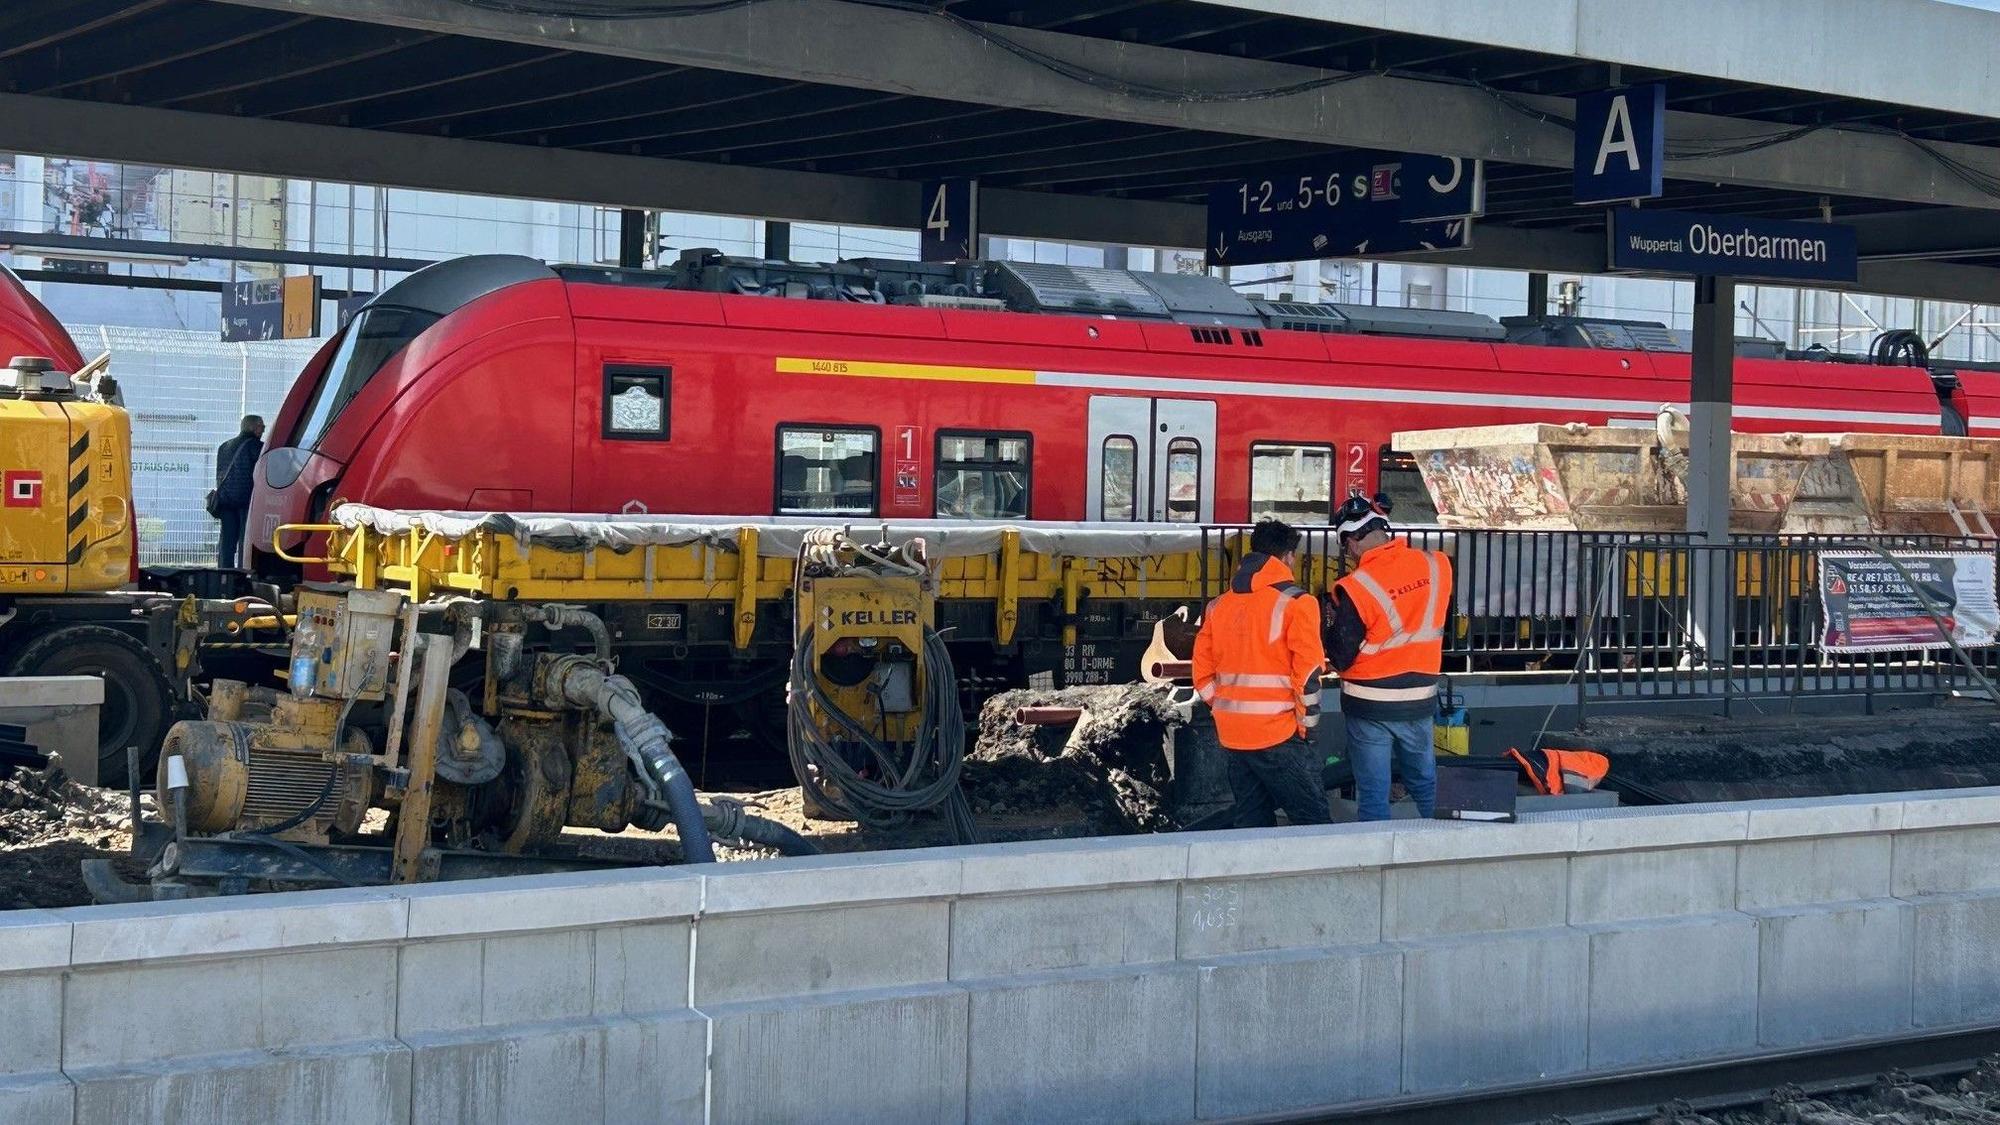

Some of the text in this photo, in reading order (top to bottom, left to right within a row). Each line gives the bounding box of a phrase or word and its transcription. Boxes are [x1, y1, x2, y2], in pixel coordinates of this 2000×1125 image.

[1593, 95, 1640, 176] A
[1239, 180, 1273, 214] 1-2
[1277, 199, 1293, 211] und
[1298, 173, 1341, 208] 5-6
[927, 184, 949, 241] 4
[1238, 229, 1273, 242] Ausgang
[1629, 223, 1827, 262] Wuppertal Oberbarmen
[235, 283, 249, 306] 1-4
[812, 361, 832, 373] 1440
[901, 428, 912, 459] 1
[131, 461, 190, 473] OTAUSGANG
[1349, 445, 1363, 474] 2
[1398, 578, 1431, 595] KELLER
[841, 610, 917, 625] KELLER
[1082, 644, 1096, 656] RIV
